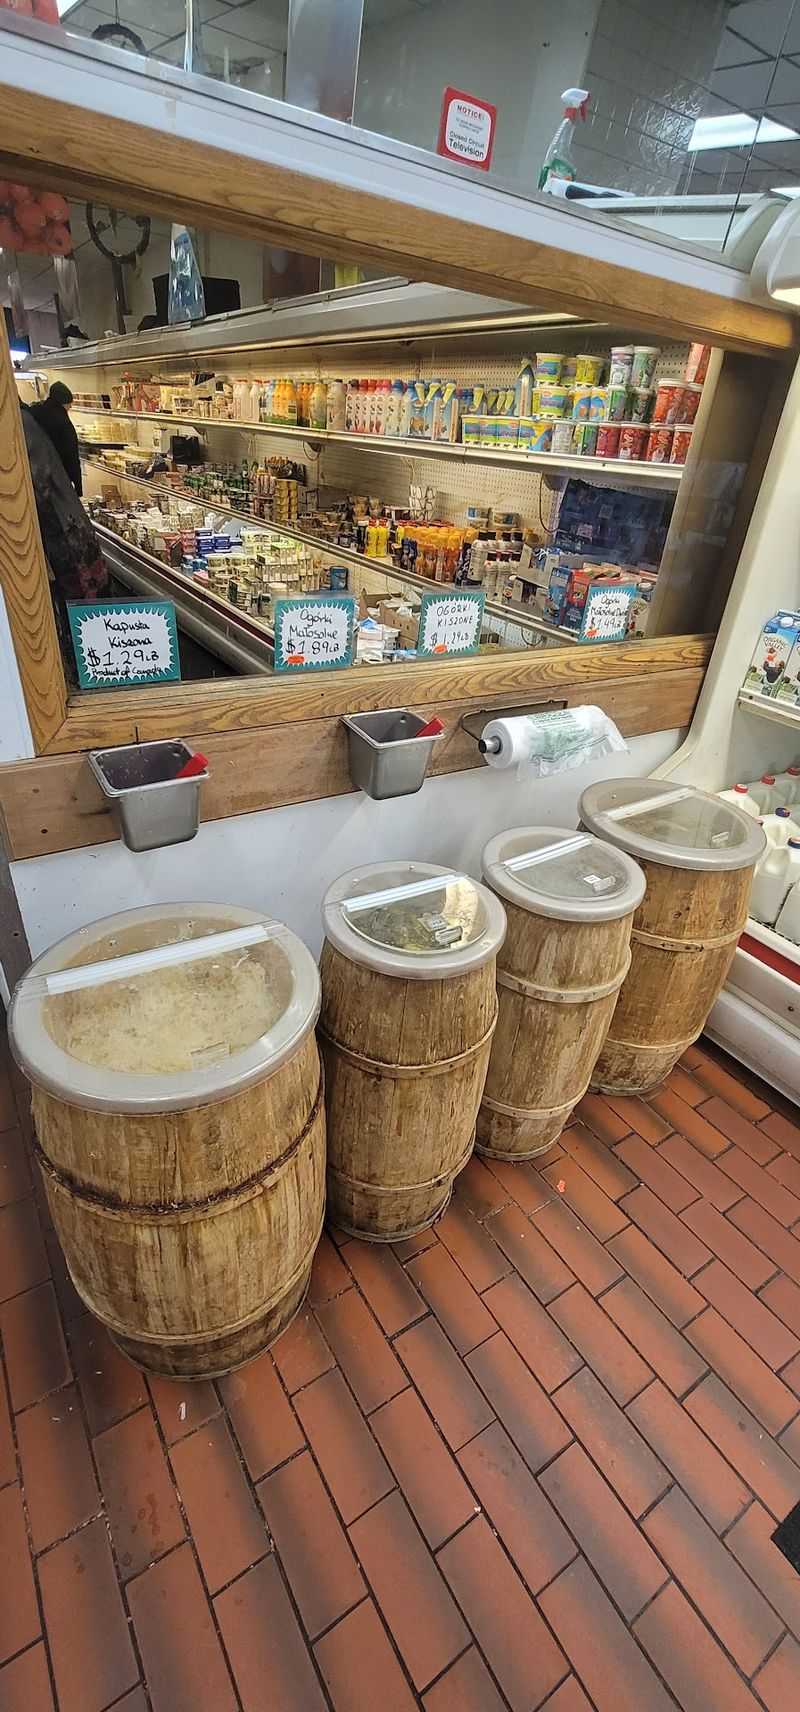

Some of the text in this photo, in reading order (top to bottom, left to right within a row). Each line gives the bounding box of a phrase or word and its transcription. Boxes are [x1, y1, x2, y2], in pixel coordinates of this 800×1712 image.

[449, 137, 484, 158] Television
[300, 608, 332, 627] Ogórki
[437, 616, 473, 628] KISZONE
[103, 618, 150, 634] Kapusta
[107, 636, 152, 649] Kiszona
[91, 664, 161, 677] Product of Canada
